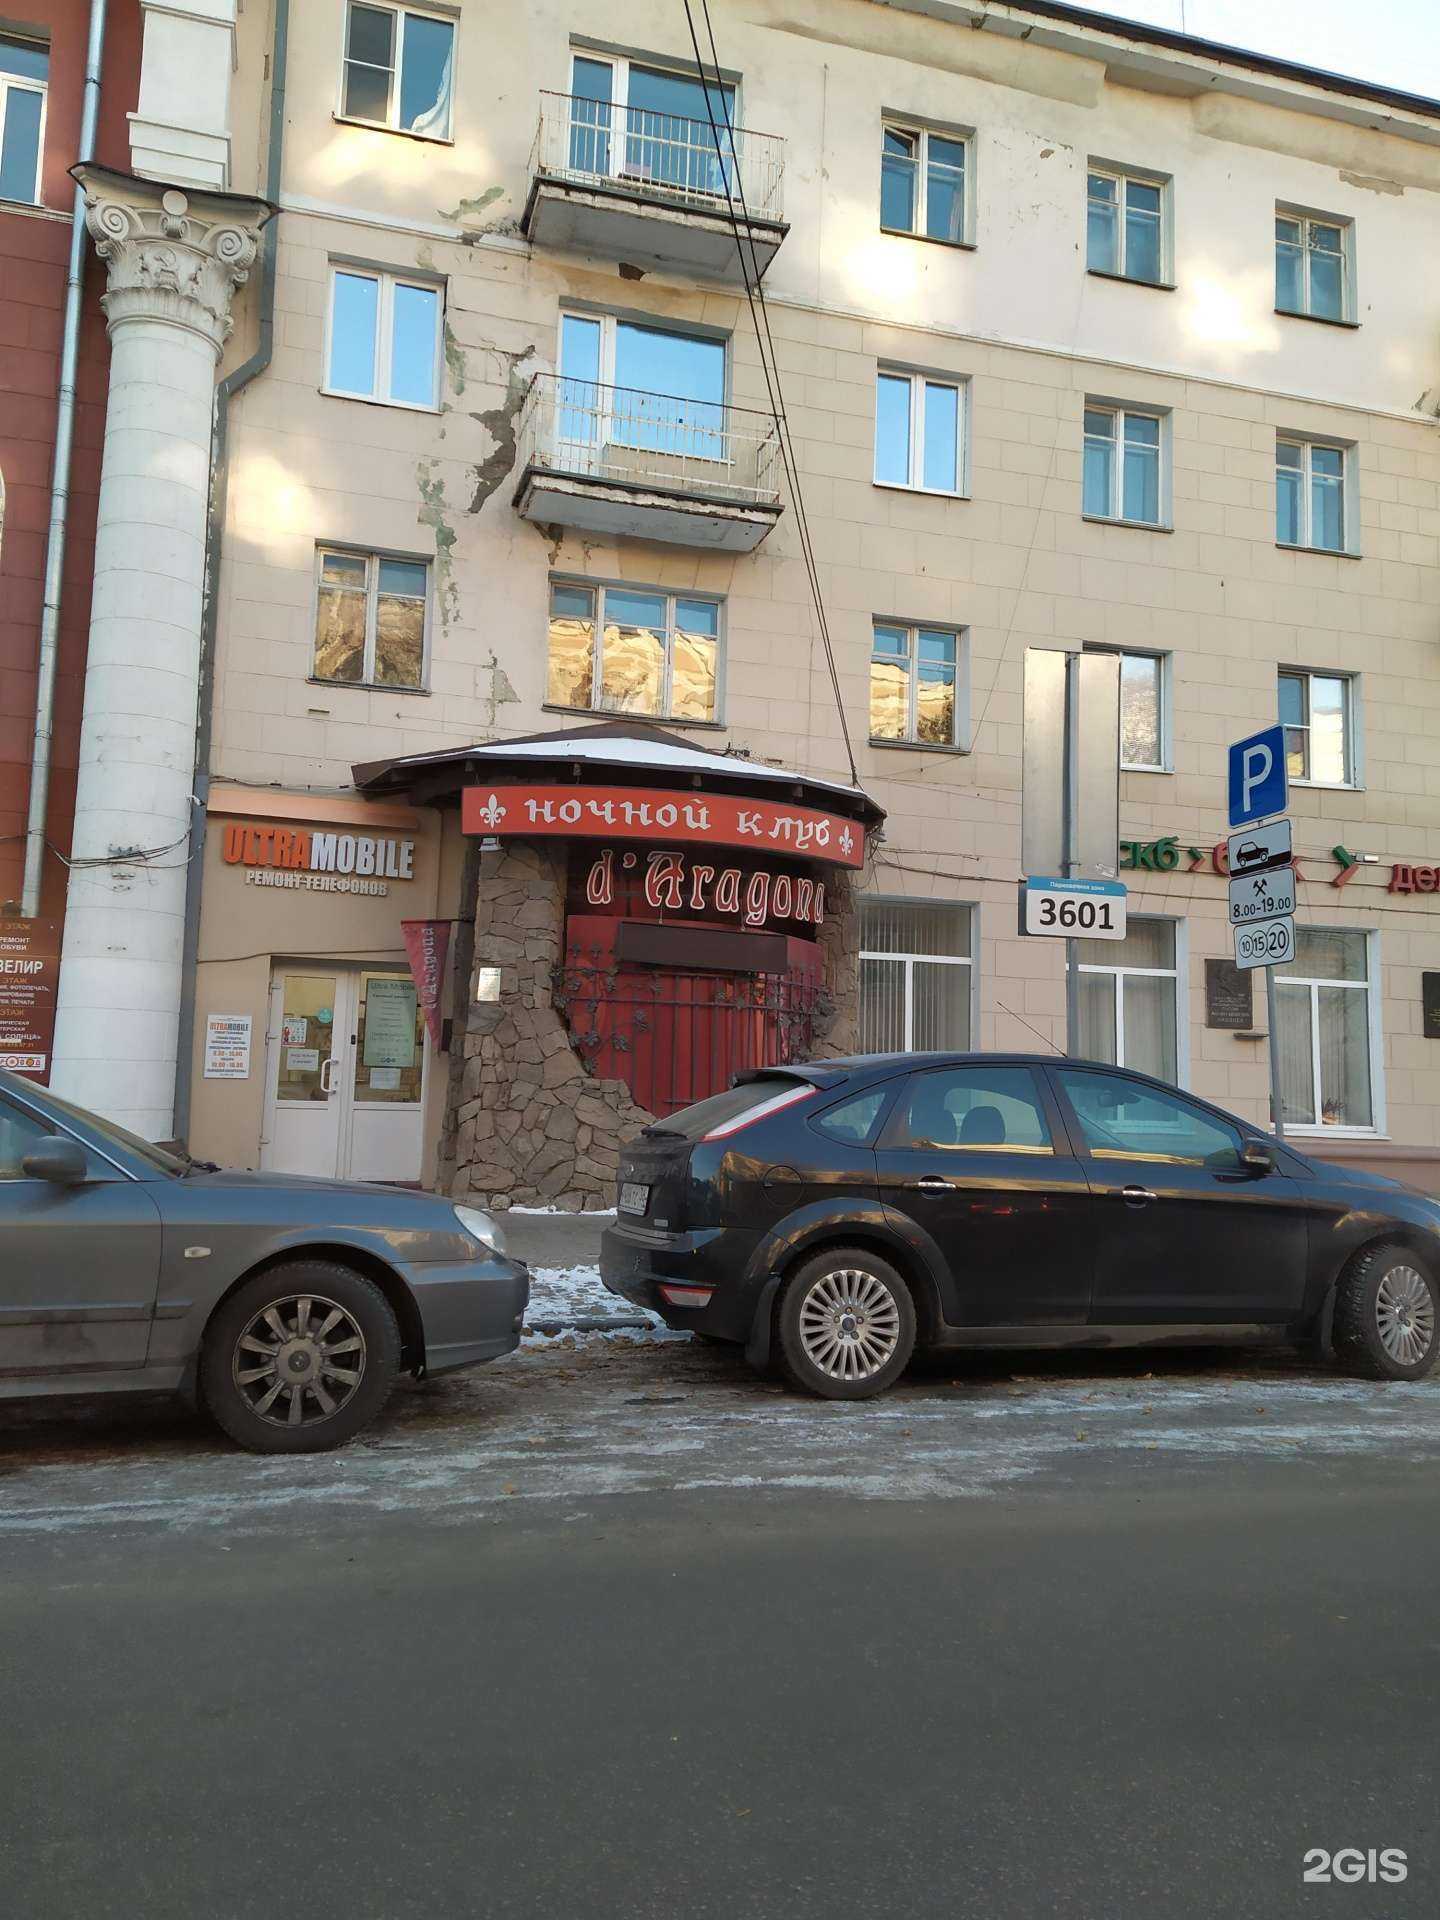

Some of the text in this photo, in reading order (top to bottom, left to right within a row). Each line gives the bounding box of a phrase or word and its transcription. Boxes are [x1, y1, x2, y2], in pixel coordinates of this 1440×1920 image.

[1242, 743, 1273, 813] P
[524, 797, 832, 849] ночной клуб
[223, 823, 415, 879] ULTRAMOBILE
[246, 870, 388, 897] РЕМОНТ ТЕЛЕФОНОВ
[1388, 864, 1440, 894] де
[1040, 898, 1114, 930] 3601
[1233, 897, 1291, 917] 8.00-19.00
[1241, 931, 1286, 952] 10 15 20
